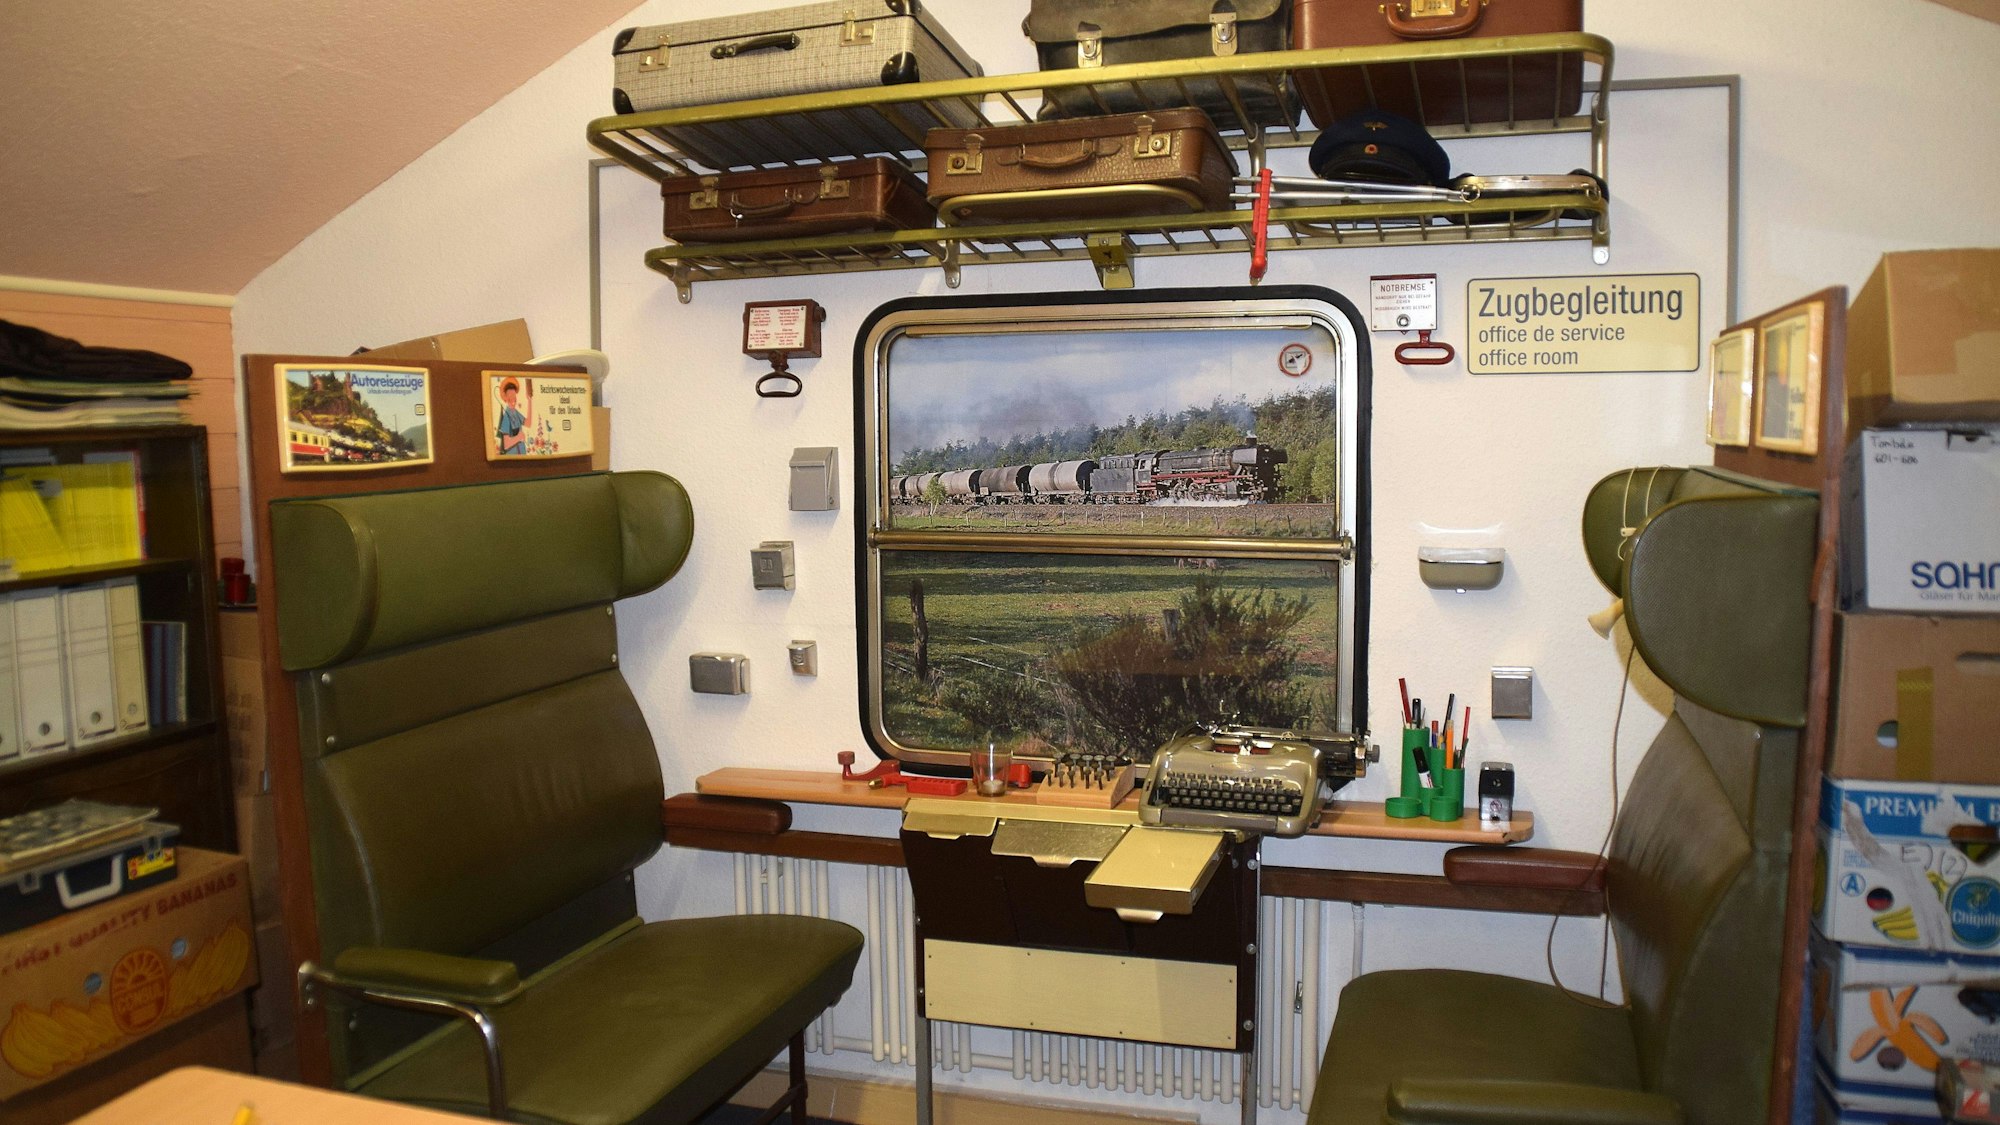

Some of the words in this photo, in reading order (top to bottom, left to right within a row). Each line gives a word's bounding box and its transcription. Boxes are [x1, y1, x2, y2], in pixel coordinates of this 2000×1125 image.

[1380, 283, 1426, 292] NOTBREMSE
[1478, 284, 1683, 323] Zugbegleitung
[1478, 325, 1527, 343] office
[1533, 325, 1555, 342] de
[1560, 323, 1625, 341] service
[1478, 349, 1527, 366] office
[1534, 351, 1578, 365] room
[351, 373, 424, 391] Autoreisezüge
[1865, 796, 1976, 819] PREMIM
